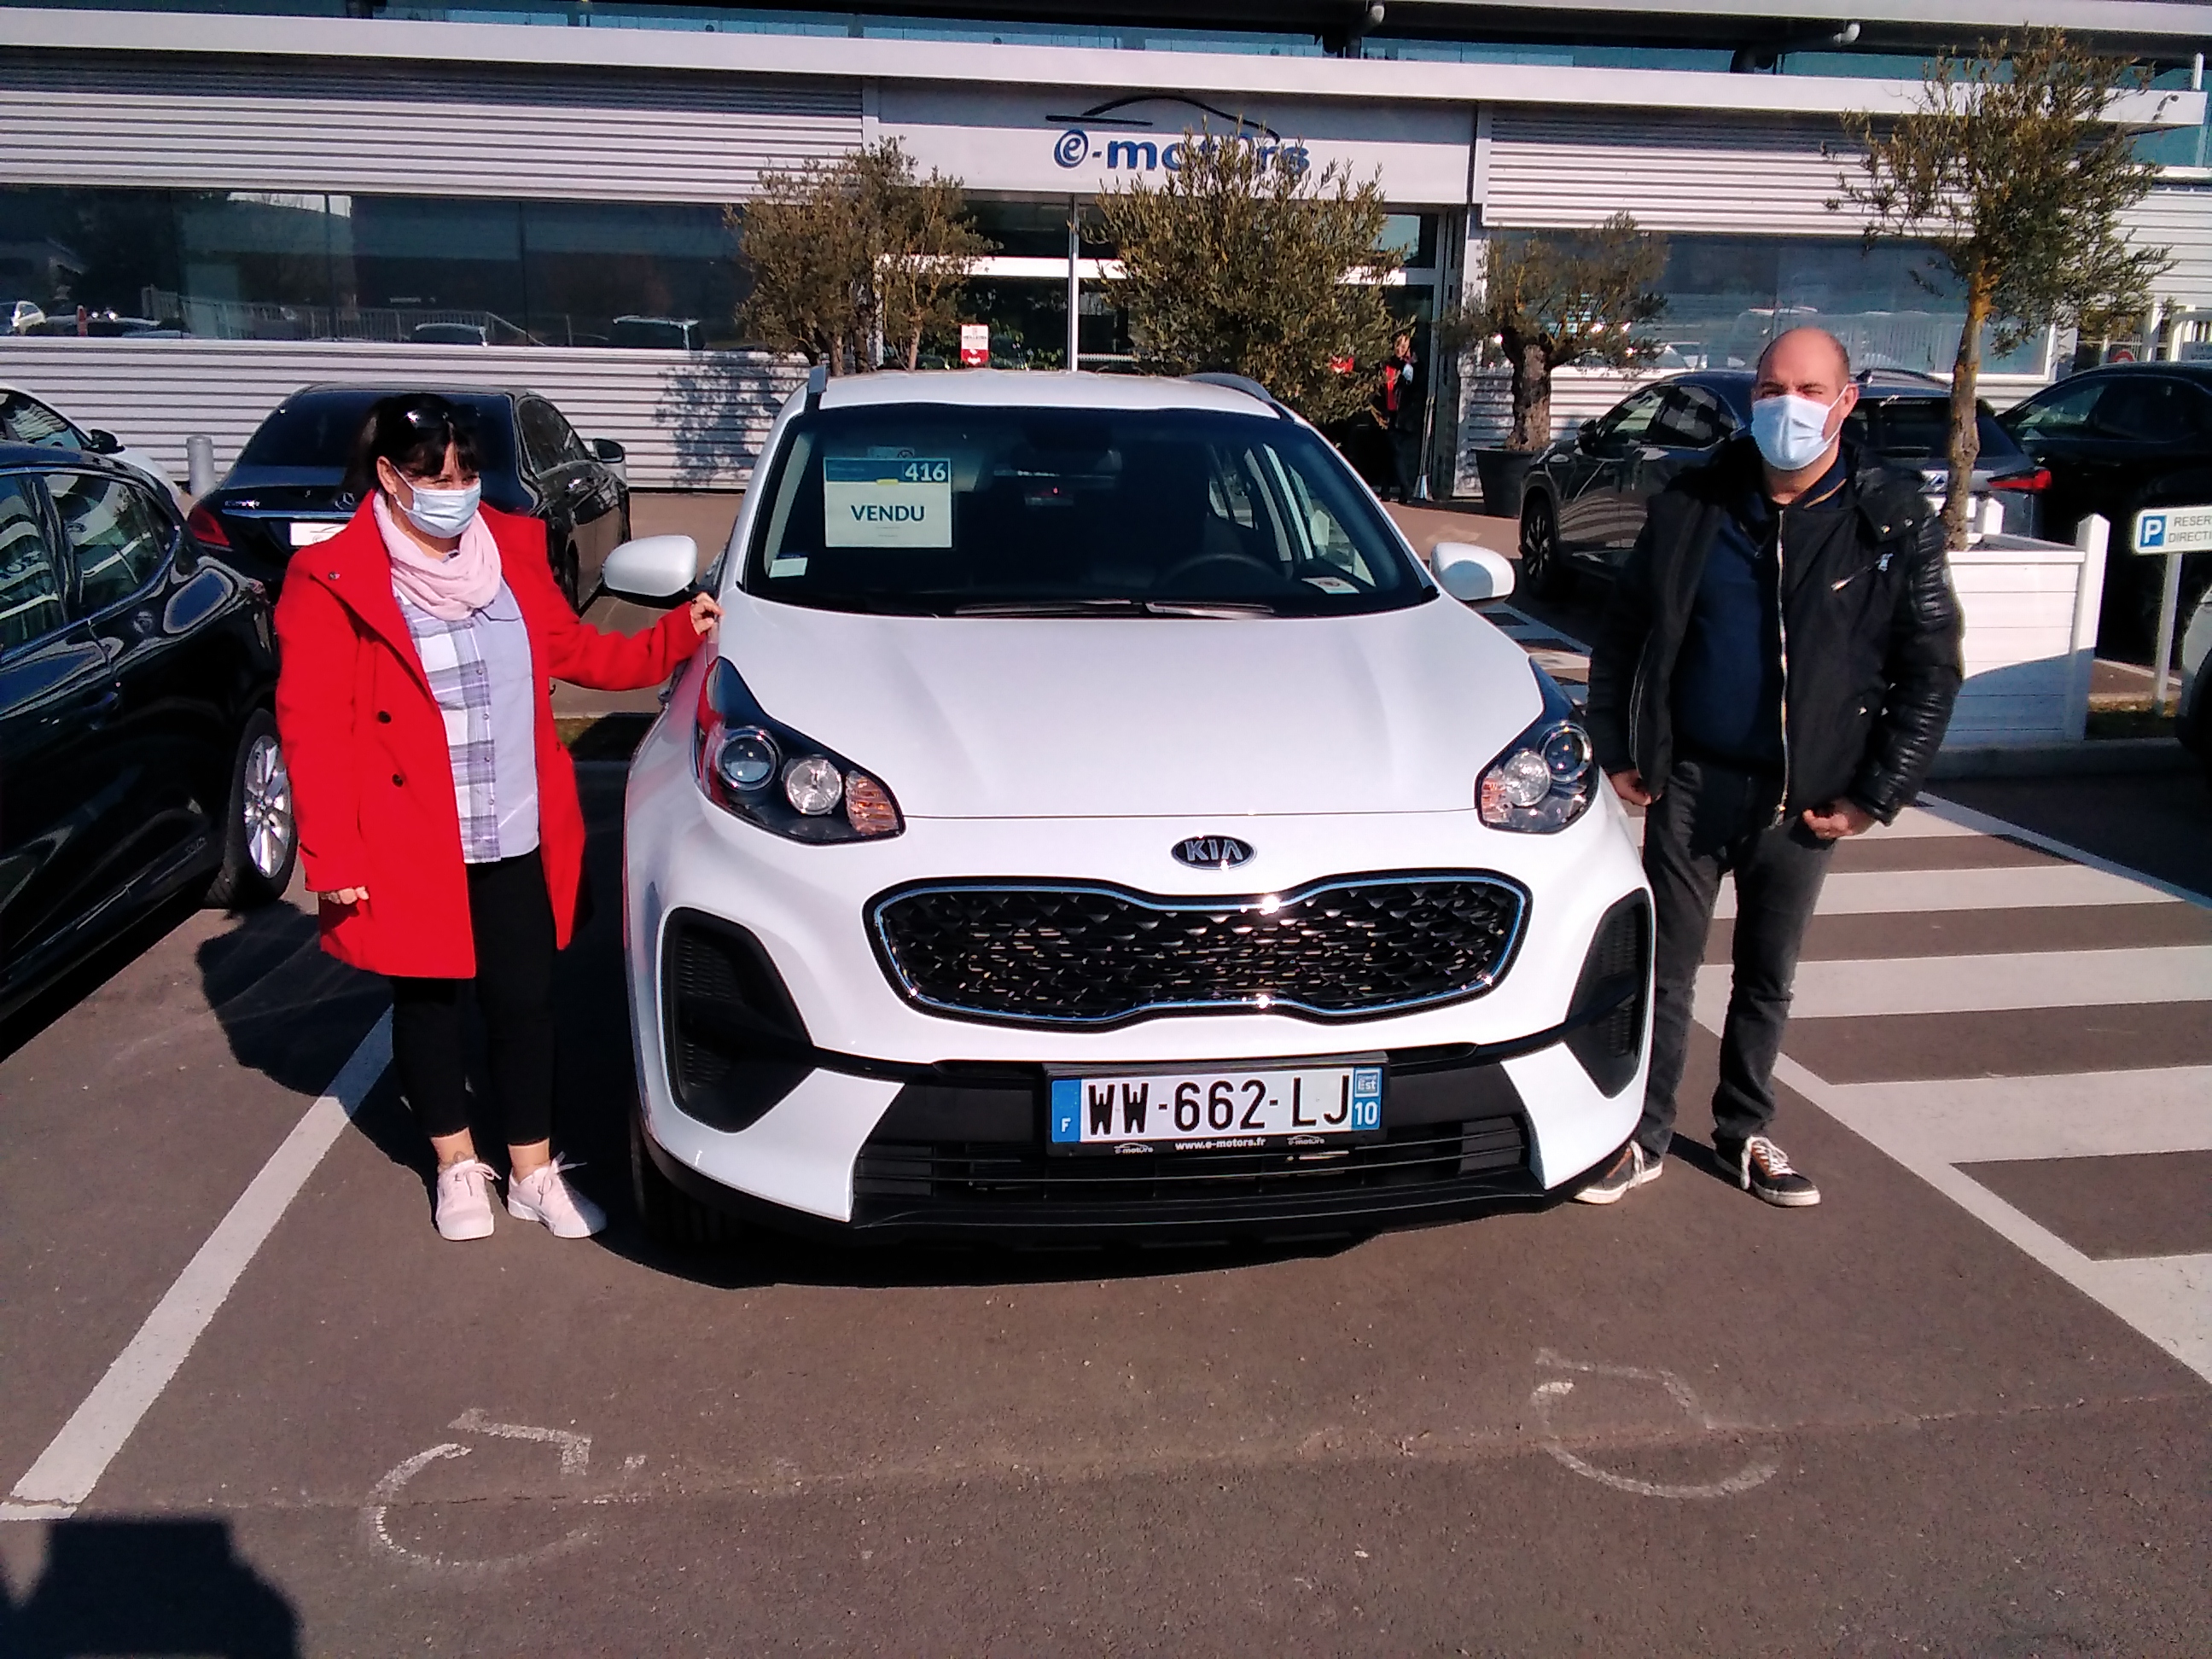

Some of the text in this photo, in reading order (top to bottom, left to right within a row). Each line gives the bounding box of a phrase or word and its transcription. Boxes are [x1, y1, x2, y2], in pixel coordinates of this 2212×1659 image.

[1054, 130, 1310, 175] e-mors
[905, 463, 946, 481] 416
[850, 505, 925, 521] VENDU
[2143, 520, 2162, 544] P
[1185, 839, 1243, 861] KIA
[1088, 1074, 1350, 1135] WW-662-LJ
[1354, 1101, 1377, 1125] 10
[1061, 1117, 1071, 1132] F
[1175, 1137, 1266, 1150] www.e-motors.fr
